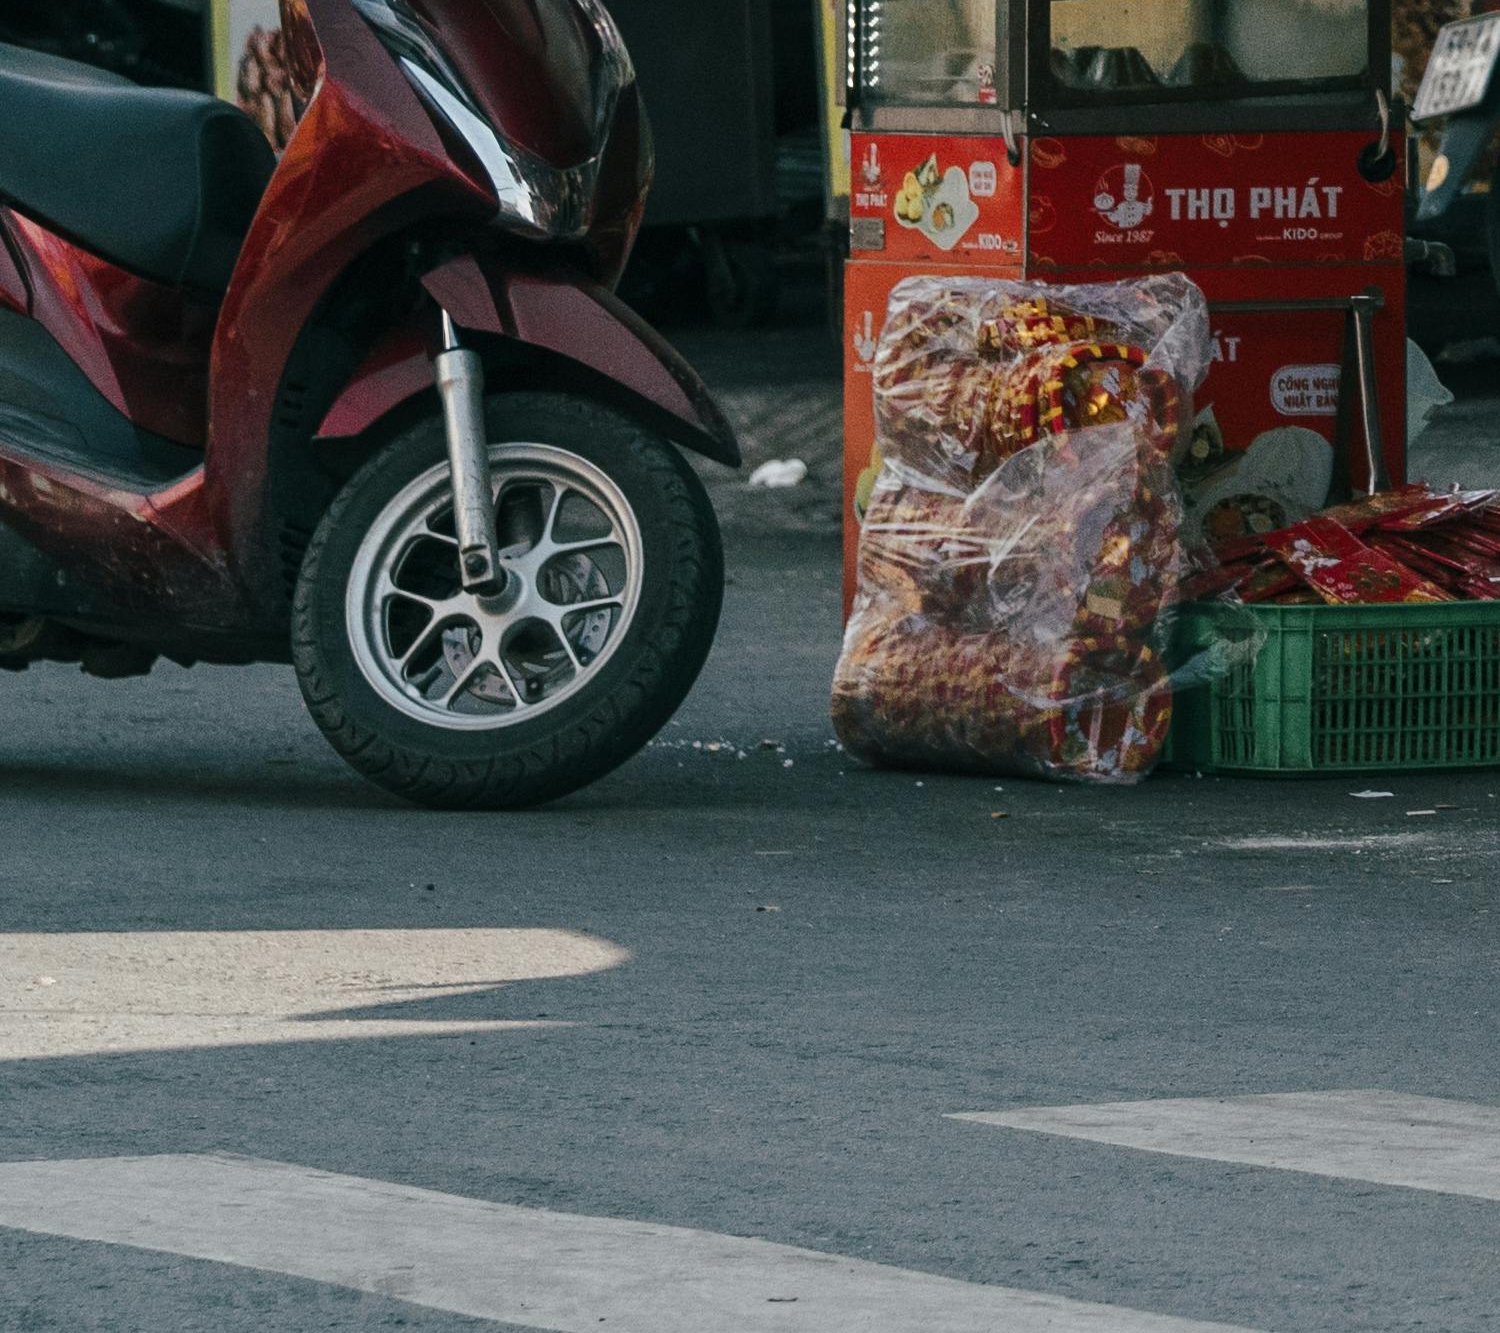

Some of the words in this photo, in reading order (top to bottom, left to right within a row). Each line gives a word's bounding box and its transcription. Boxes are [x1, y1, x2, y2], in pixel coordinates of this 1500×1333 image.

[1165, 187, 1235, 229] THỌ
[1249, 176, 1344, 219] PHÁT
[1094, 230, 1125, 245] Since
[1125, 230, 1155, 244] 1987
[1283, 228, 1318, 241] KIDO
